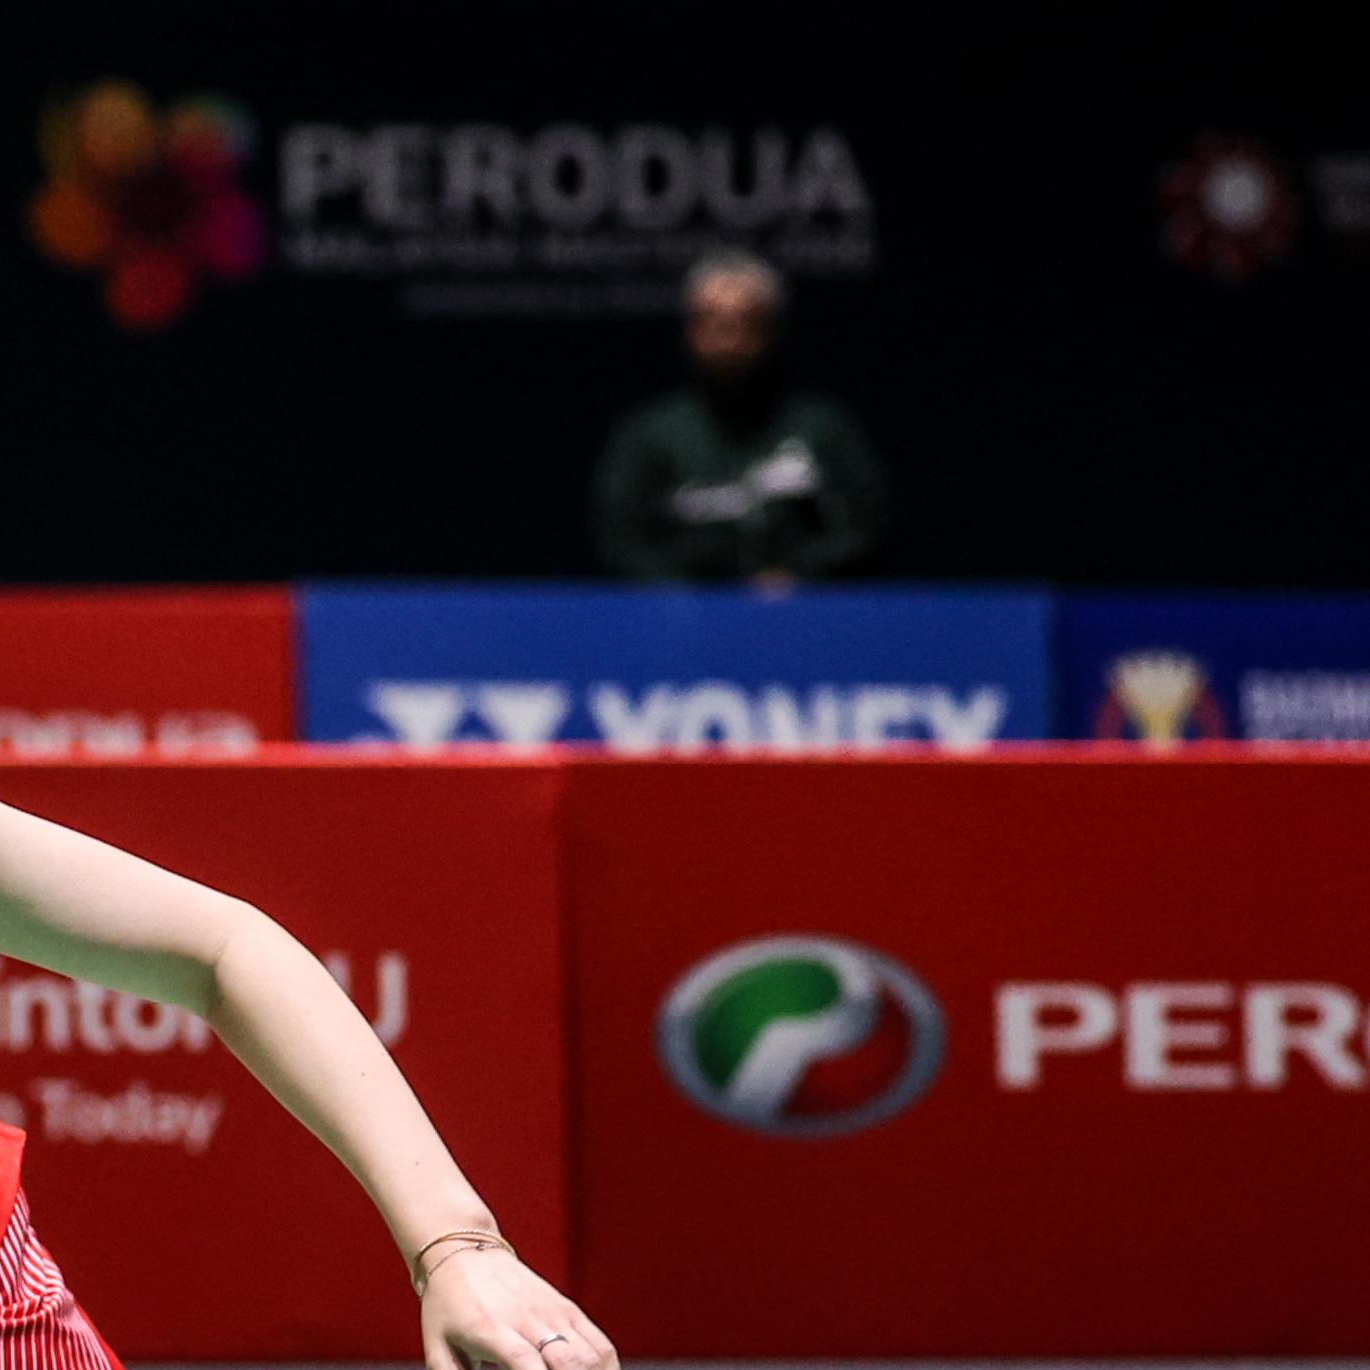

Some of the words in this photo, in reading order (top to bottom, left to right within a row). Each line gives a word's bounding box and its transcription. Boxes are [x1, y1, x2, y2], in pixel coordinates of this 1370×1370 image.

[279, 120, 875, 232] PERODUA
[993, 978, 1370, 1092] PER
[31, 1078, 225, 1156] Today
